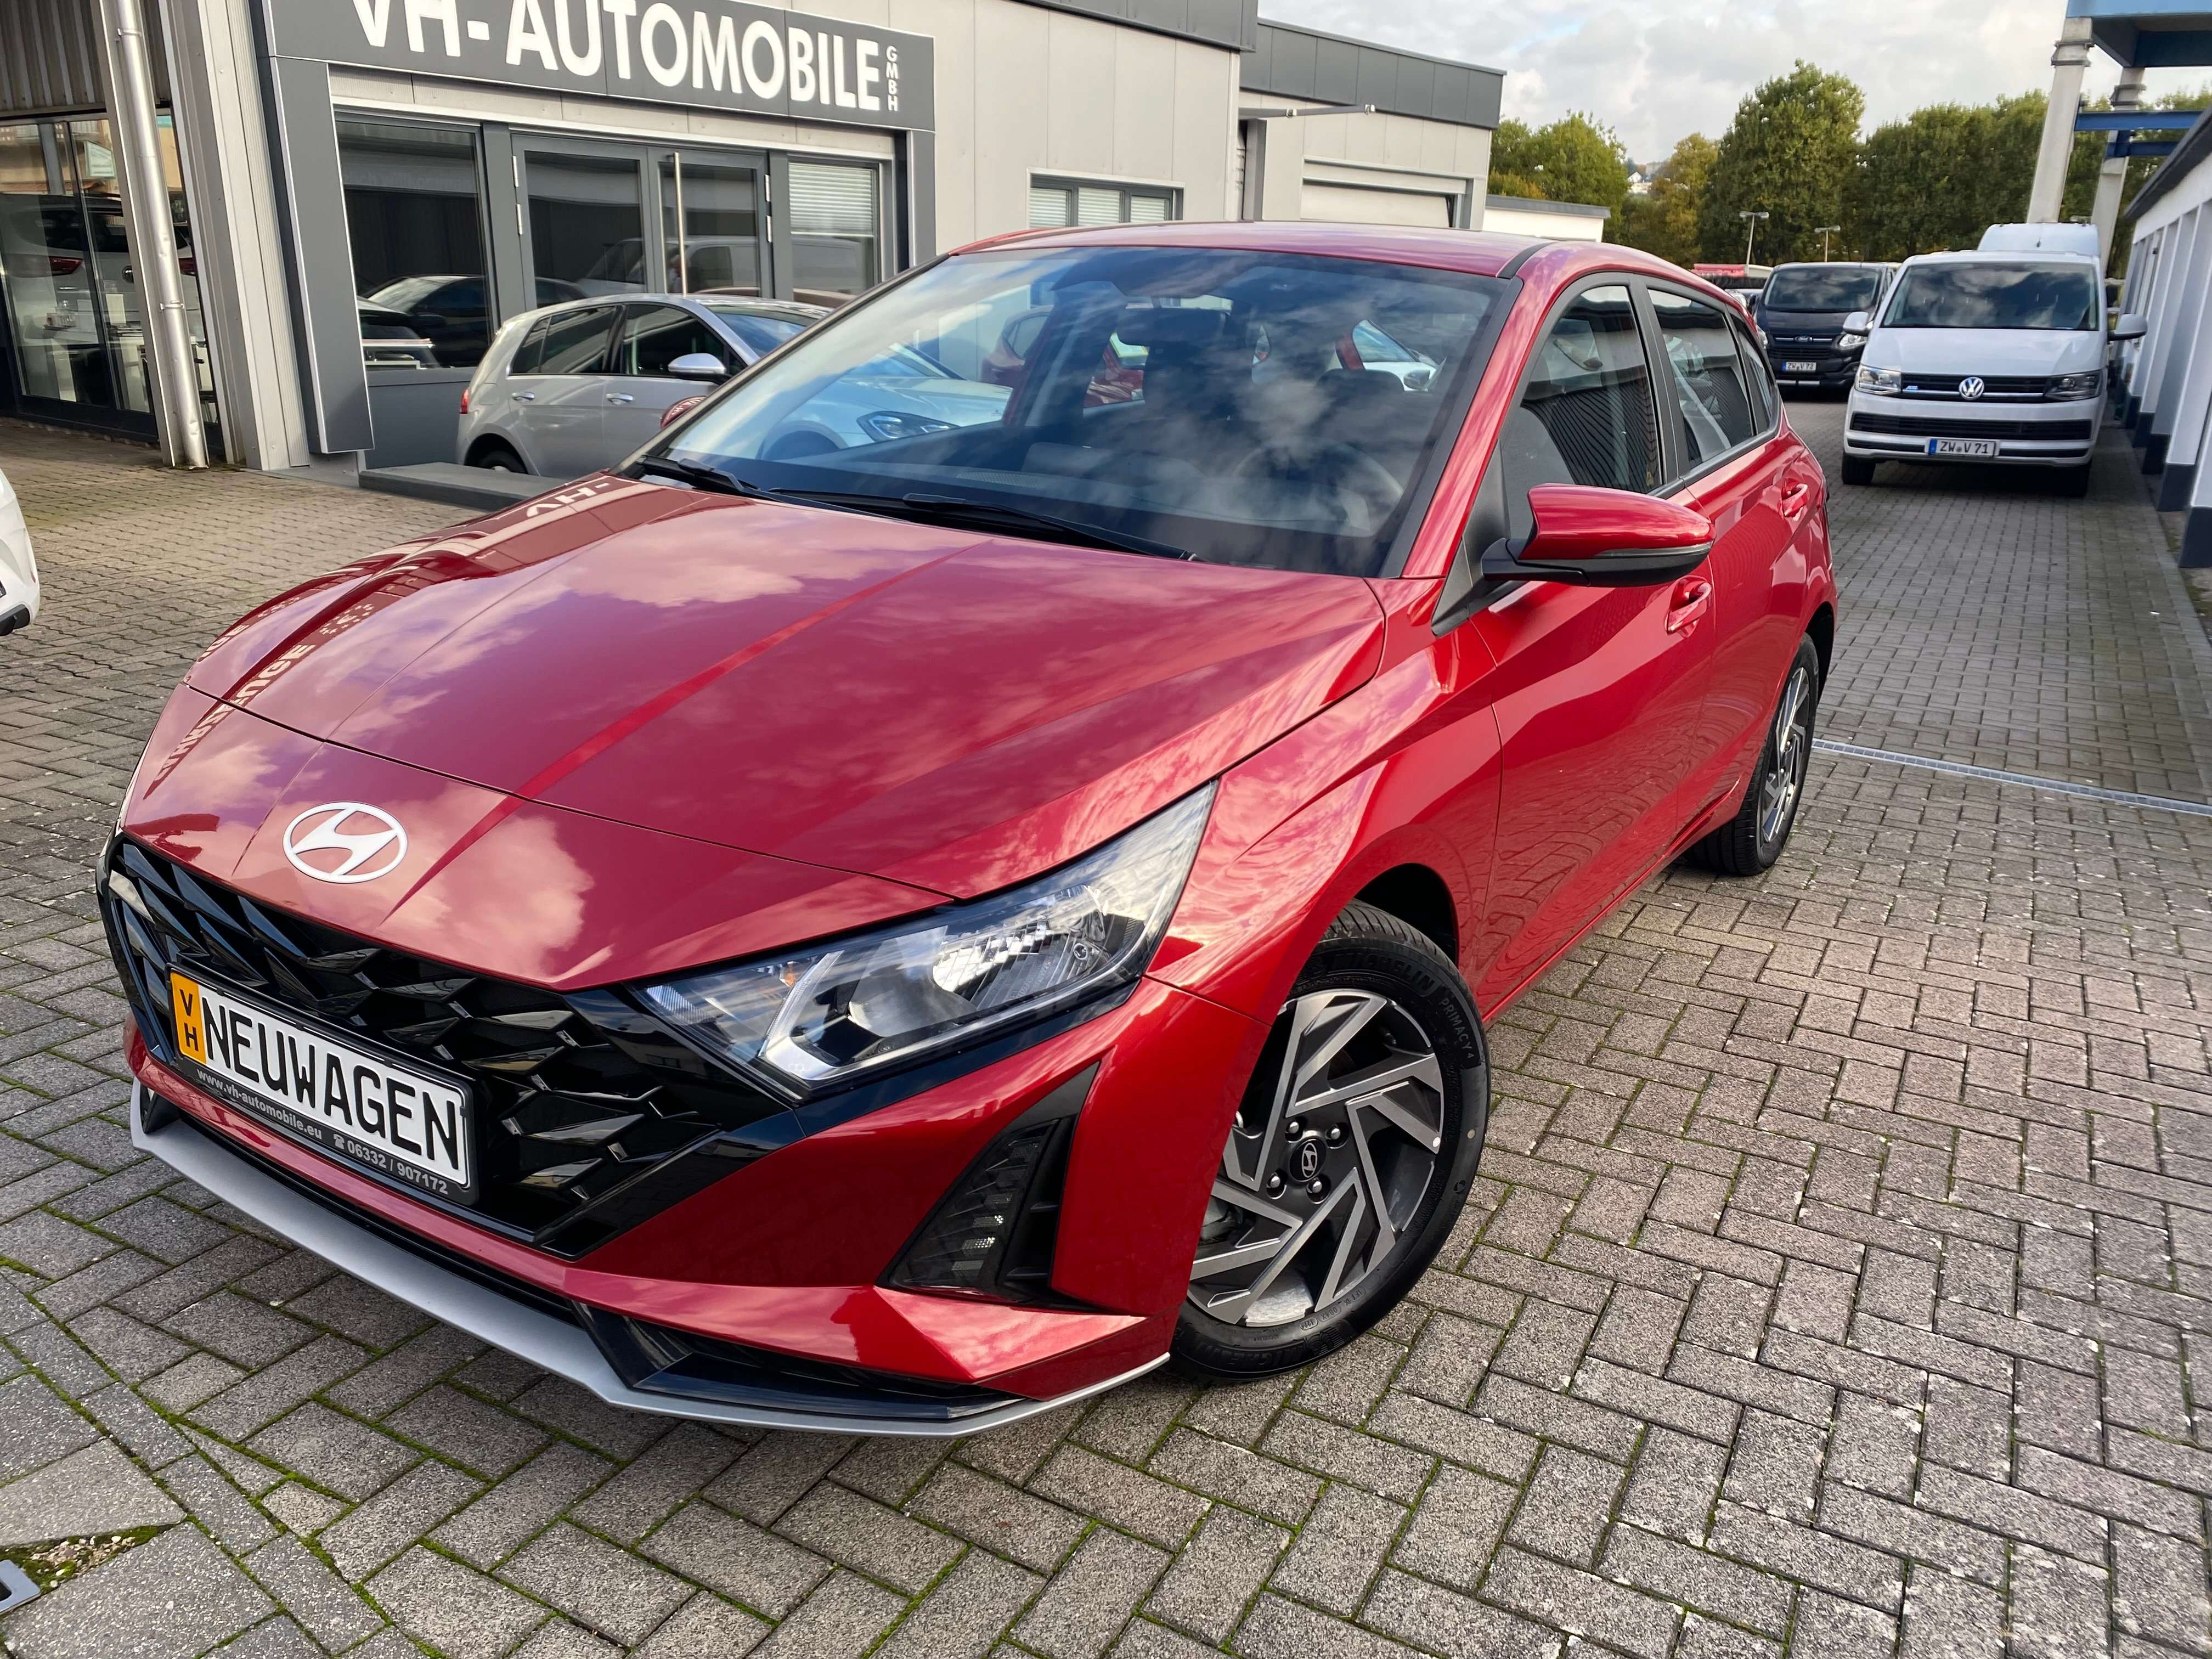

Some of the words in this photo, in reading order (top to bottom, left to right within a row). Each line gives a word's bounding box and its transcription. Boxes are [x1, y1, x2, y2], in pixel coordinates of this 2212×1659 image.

[353, 0, 490, 57] VH-
[506, 0, 881, 111] AUTOMOBILE
[885, 46, 899, 111] GMBH
[1940, 441, 1956, 452] ZW
[1963, 442, 1972, 453] V
[1974, 443, 1989, 454] 71
[1438, 997, 1472, 1050] PRIMACY
[202, 997, 459, 1171] NEUWAGEN
[196, 1069, 323, 1140] www.vh-automobile.eu
[347, 1140, 387, 1169] 06332
[390, 1159, 394, 1172] /
[397, 1162, 449, 1195] 907172
